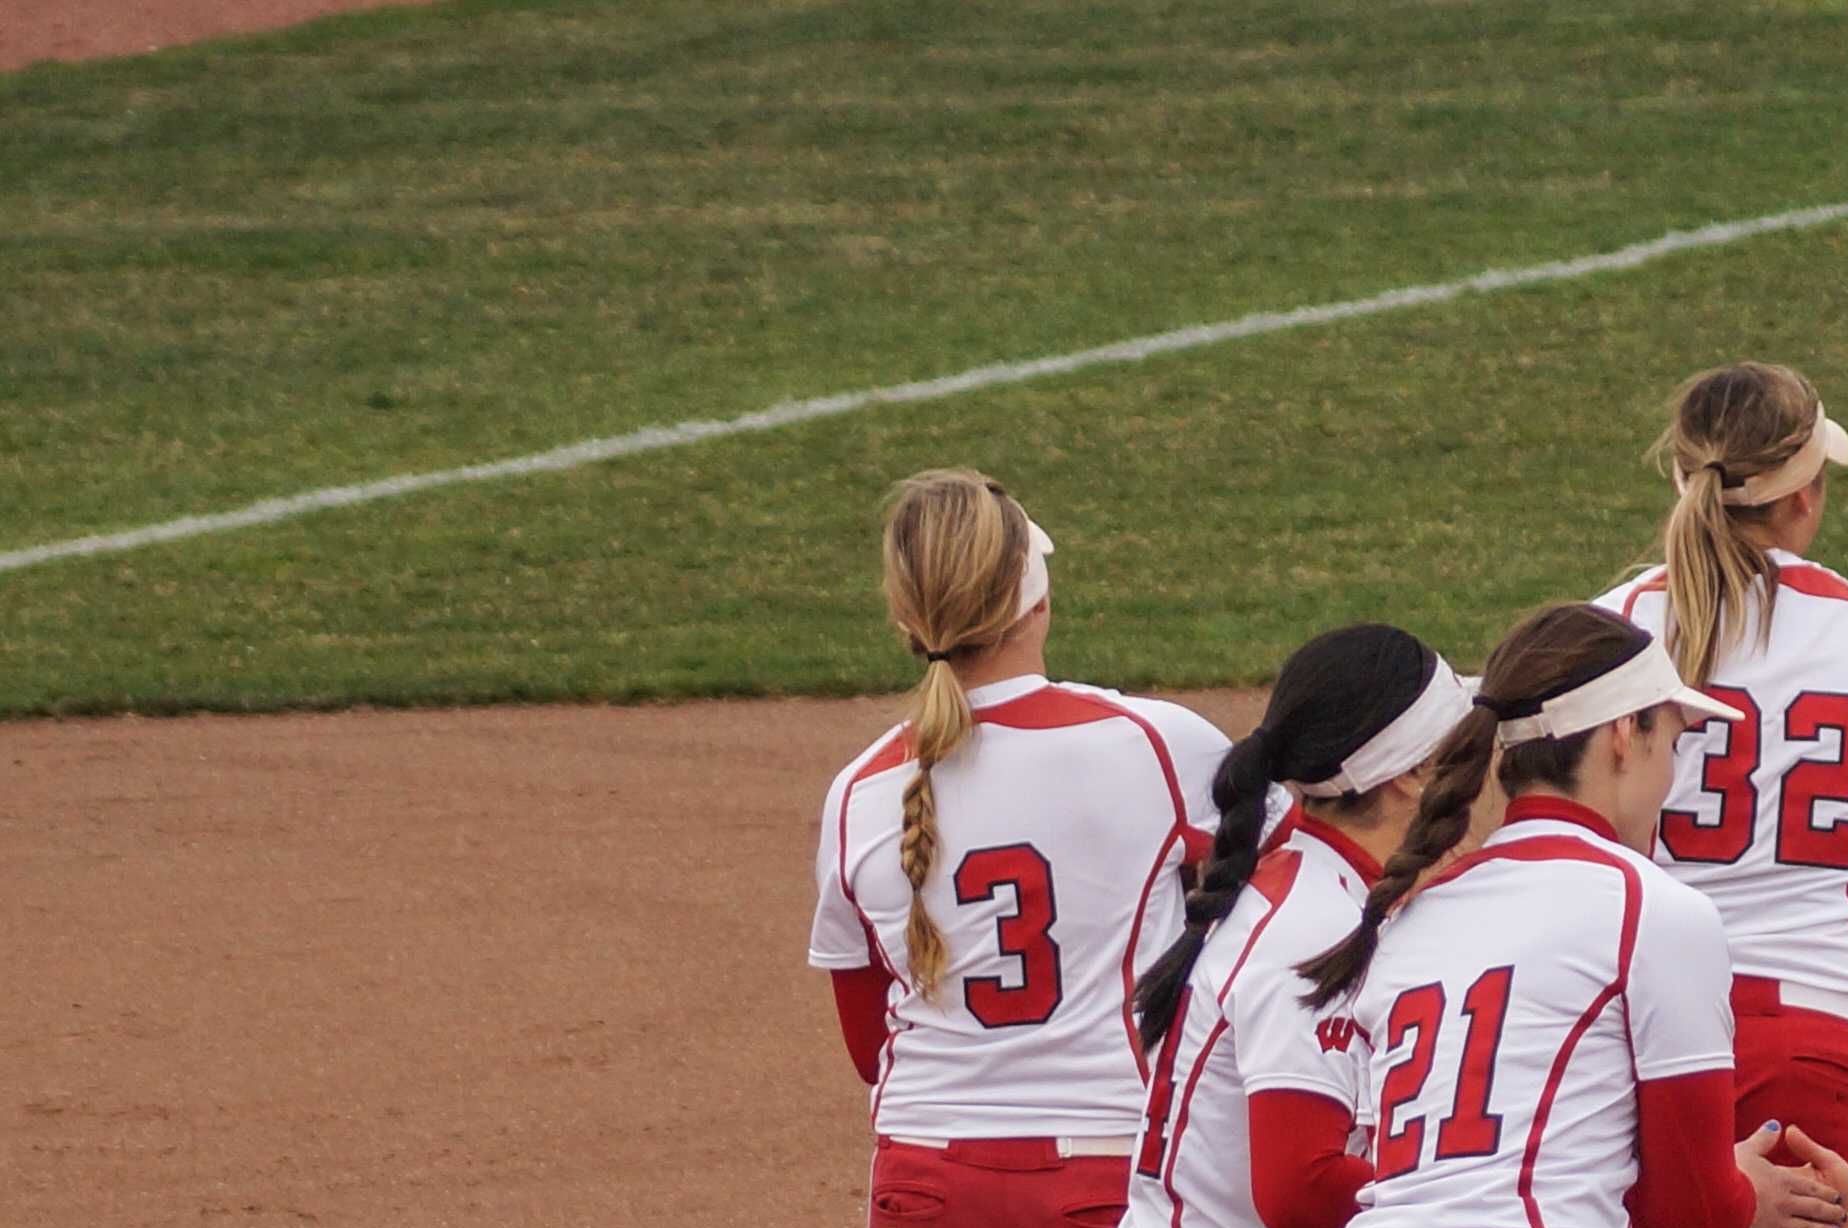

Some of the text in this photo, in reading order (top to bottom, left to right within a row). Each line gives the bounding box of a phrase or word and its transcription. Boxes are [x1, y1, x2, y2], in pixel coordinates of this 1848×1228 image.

[954, 842, 1063, 1029] 3
[1316, 1016, 1355, 1054] W
[1375, 964, 1515, 1184] 21
